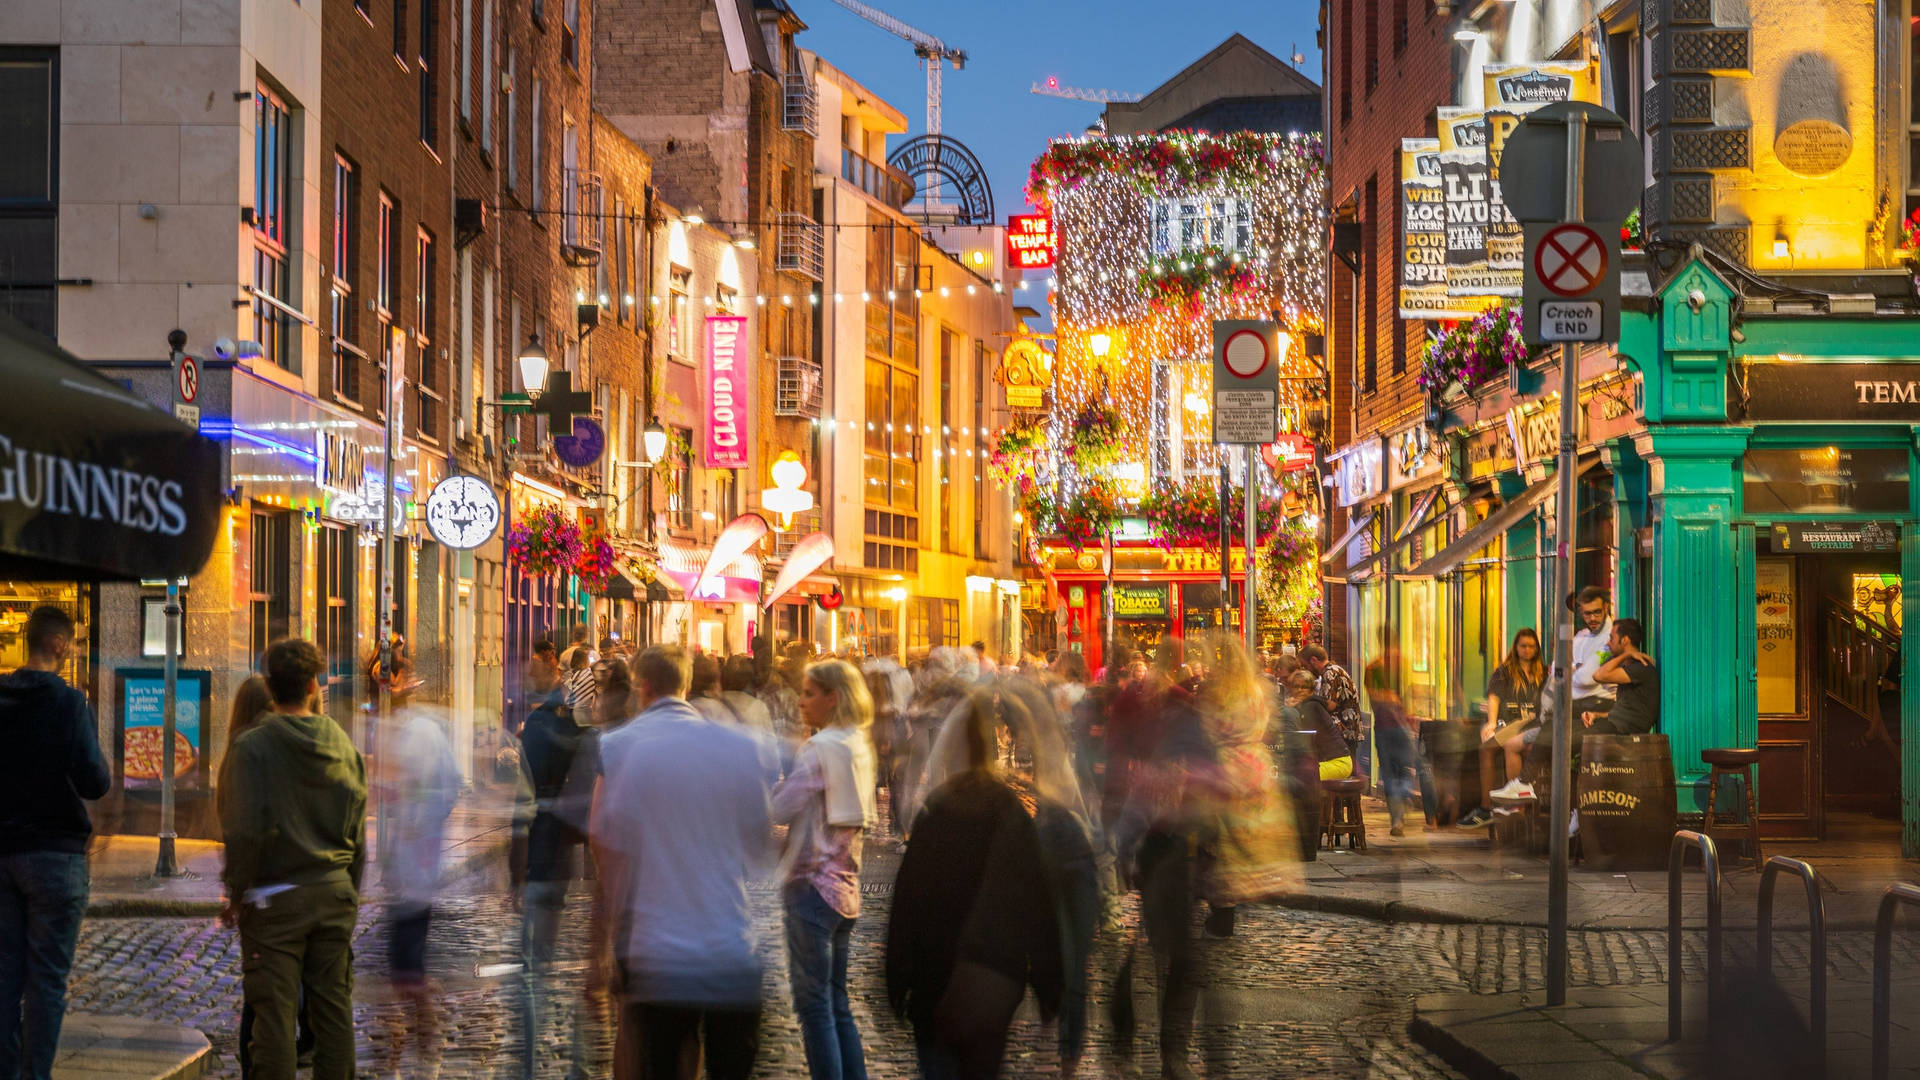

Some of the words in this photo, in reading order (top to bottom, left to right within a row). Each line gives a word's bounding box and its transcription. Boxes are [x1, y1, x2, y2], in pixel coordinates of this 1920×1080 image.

[1445, 173, 1487, 201] LI
[1406, 203, 1444, 220] LOC
[1447, 202, 1488, 222] MU
[1020, 219, 1047, 233] THE
[1406, 220, 1444, 230] INTERN
[1447, 227, 1482, 239] TILL
[1009, 233, 1058, 249] TEMPLE
[1448, 239, 1482, 250] LATE
[1021, 250, 1048, 264] BAR
[1555, 322, 1588, 334] END
[713, 319, 740, 371] NINE
[1855, 380, 1920, 403] TEM
[713, 376, 739, 447] CLOUD
[1802, 534, 1862, 542] RESTAURANT
[1811, 541, 1854, 549] UPSTAIRS
[1162, 552, 1221, 571] THE
[1113, 593, 1160, 612] TOBACCO
[1580, 789, 1637, 809] JAMESON
